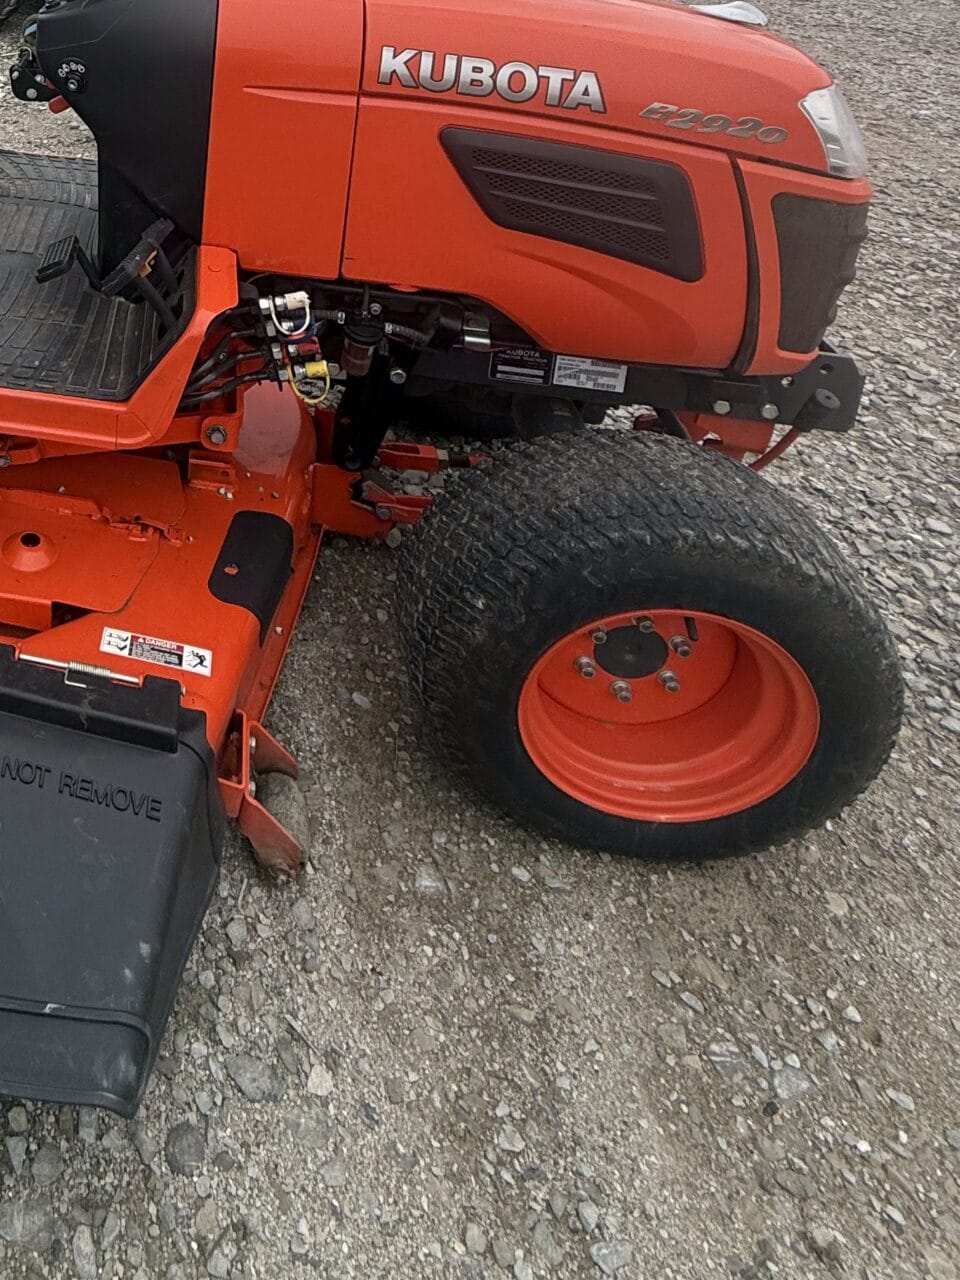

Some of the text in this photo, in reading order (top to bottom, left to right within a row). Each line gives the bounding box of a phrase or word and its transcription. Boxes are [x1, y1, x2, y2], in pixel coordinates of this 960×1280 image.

[377, 45, 608, 114] KUBOTA
[639, 102, 790, 144] B2920
[145, 639, 178, 651] DANGER
[0, 756, 51, 789] NOT
[58, 771, 163, 822] REMOVE
